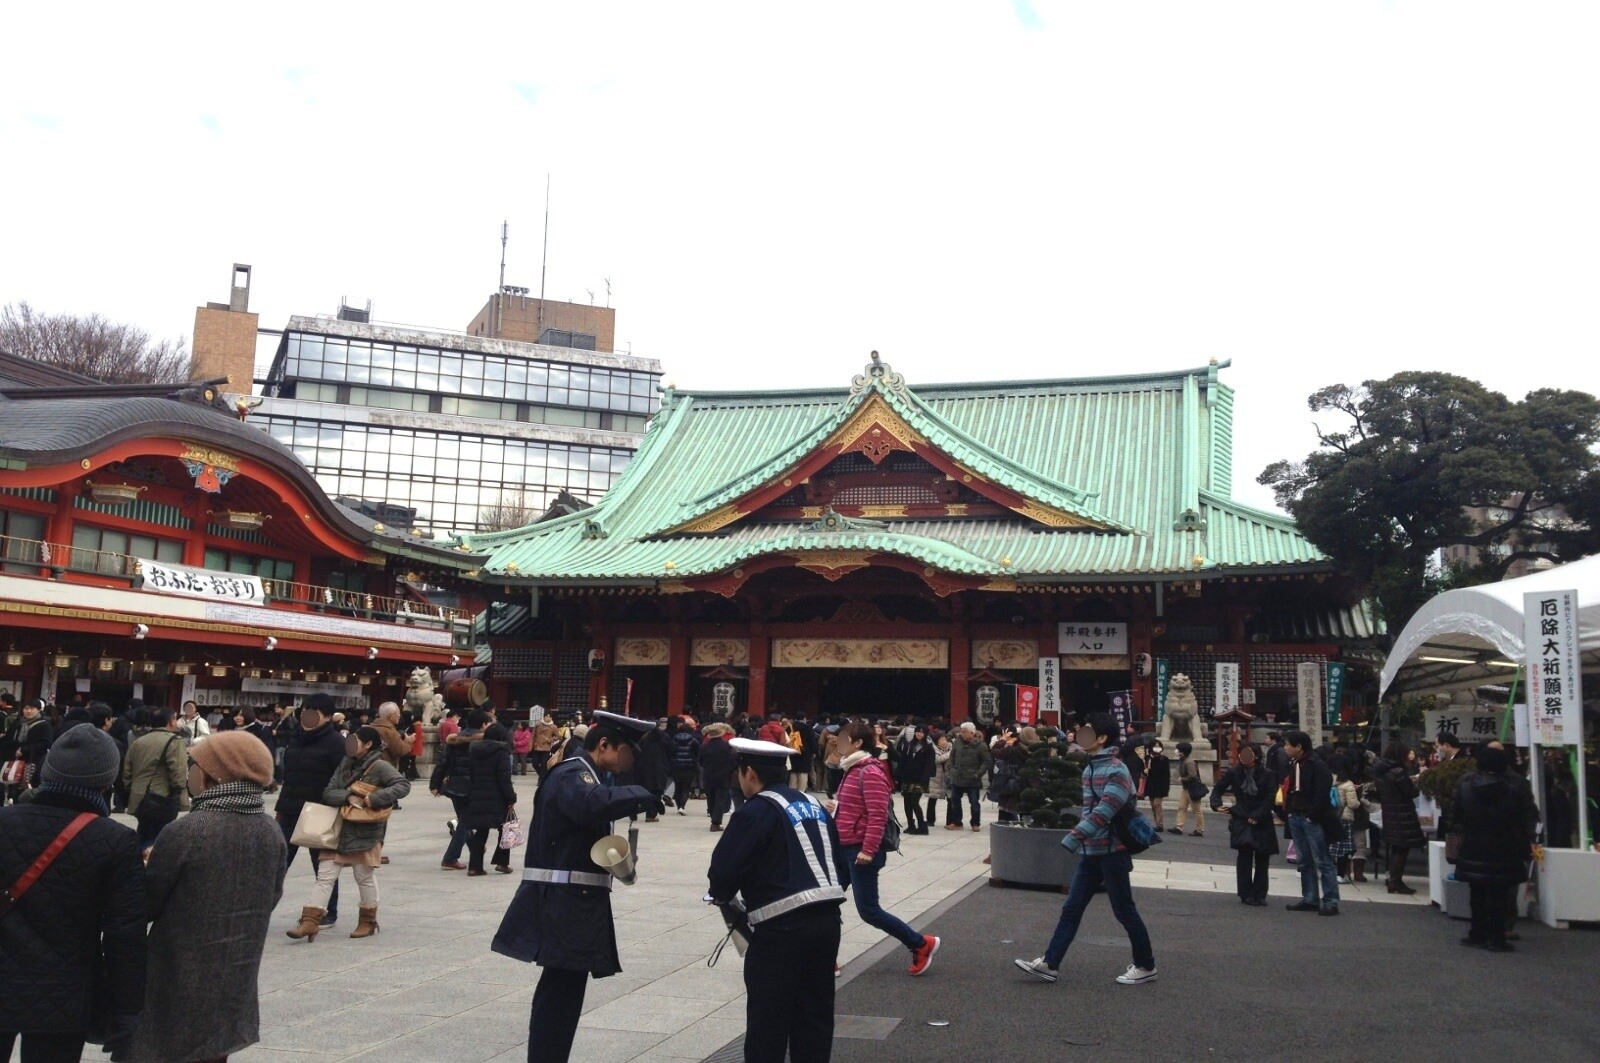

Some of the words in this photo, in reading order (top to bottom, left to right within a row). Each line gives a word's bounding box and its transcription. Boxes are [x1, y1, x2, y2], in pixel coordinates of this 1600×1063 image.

[149, 565, 256, 599] おふだ・お守り
[1079, 640, 1104, 650] 入口
[1540, 598, 1563, 715] 厄除大祈願祭
[1436, 715, 1516, 735] 祈願
